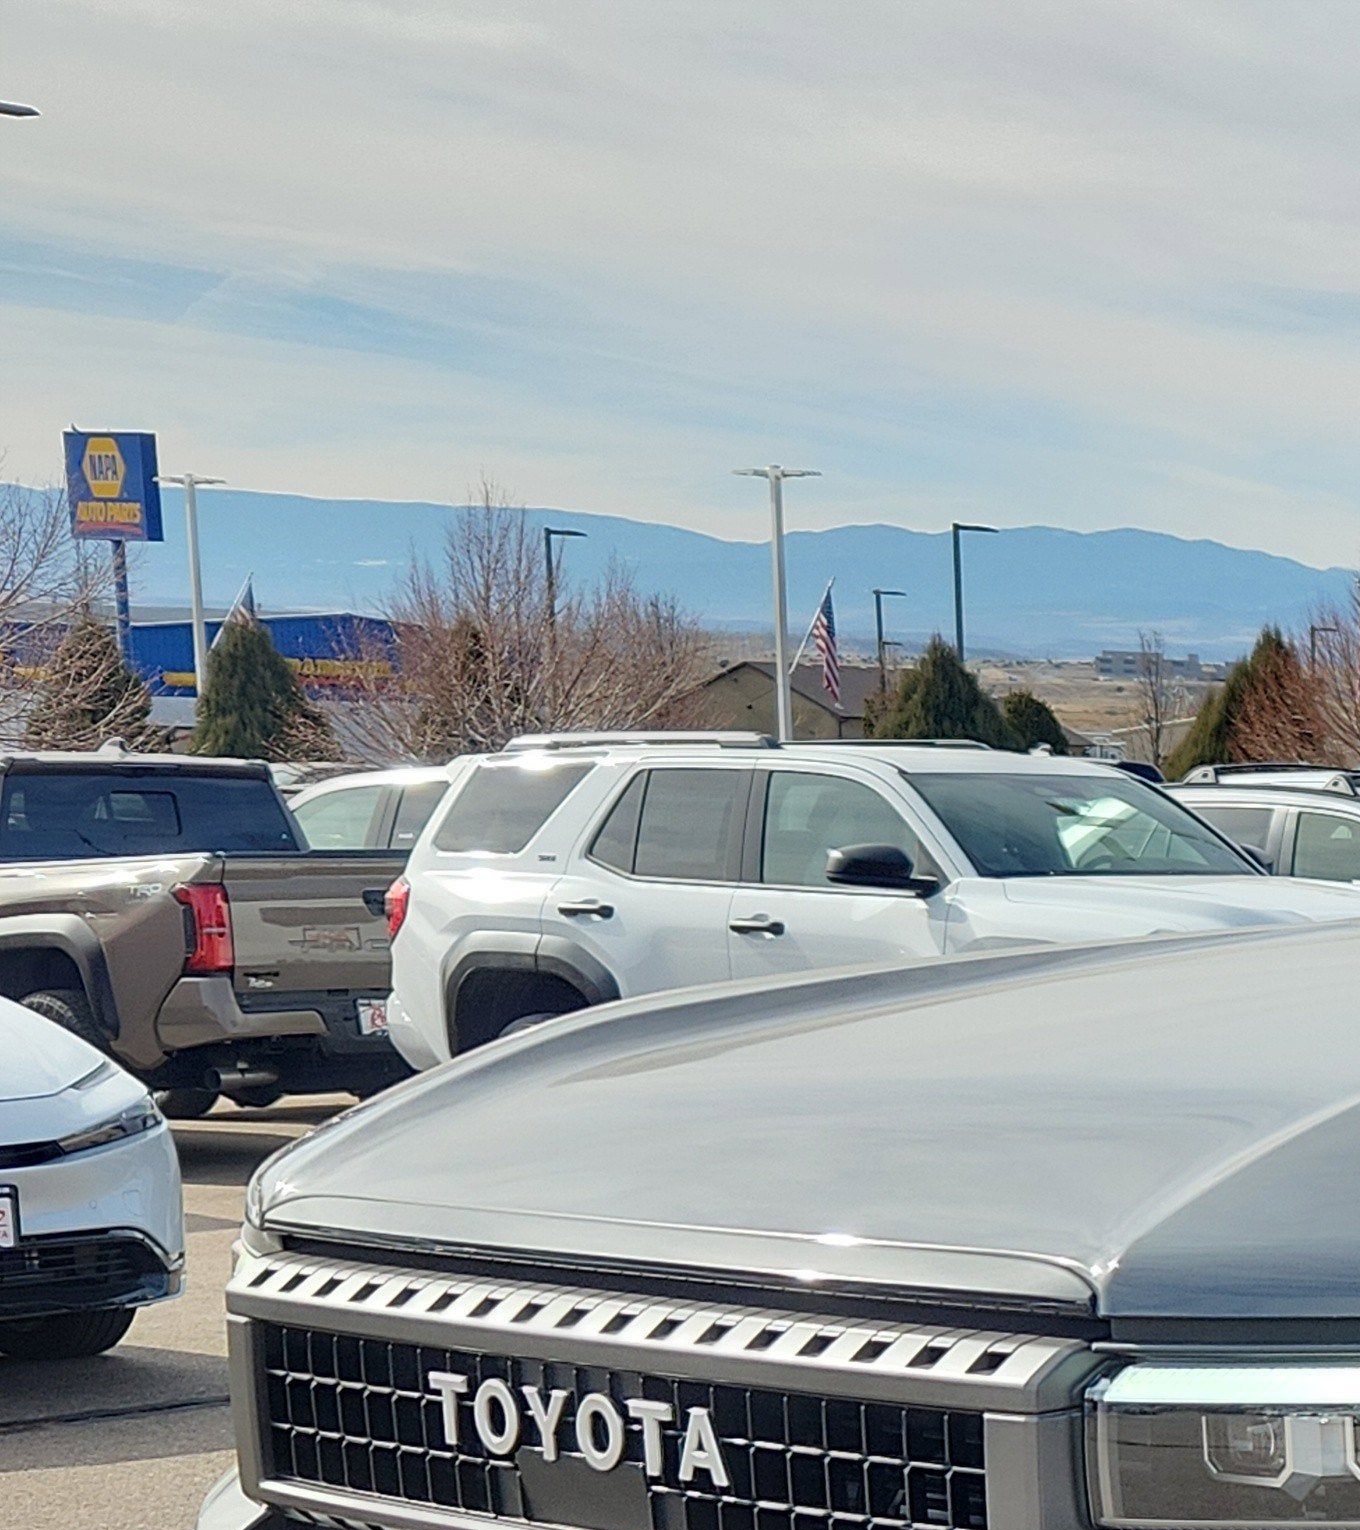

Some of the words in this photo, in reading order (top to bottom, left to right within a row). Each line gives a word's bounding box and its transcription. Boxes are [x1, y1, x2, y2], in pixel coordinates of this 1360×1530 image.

[88, 453, 119, 481] NAPA
[76, 501, 105, 522] AUTO
[106, 502, 141, 524] PARTS
[427, 1370, 731, 1488] TOYOTA
